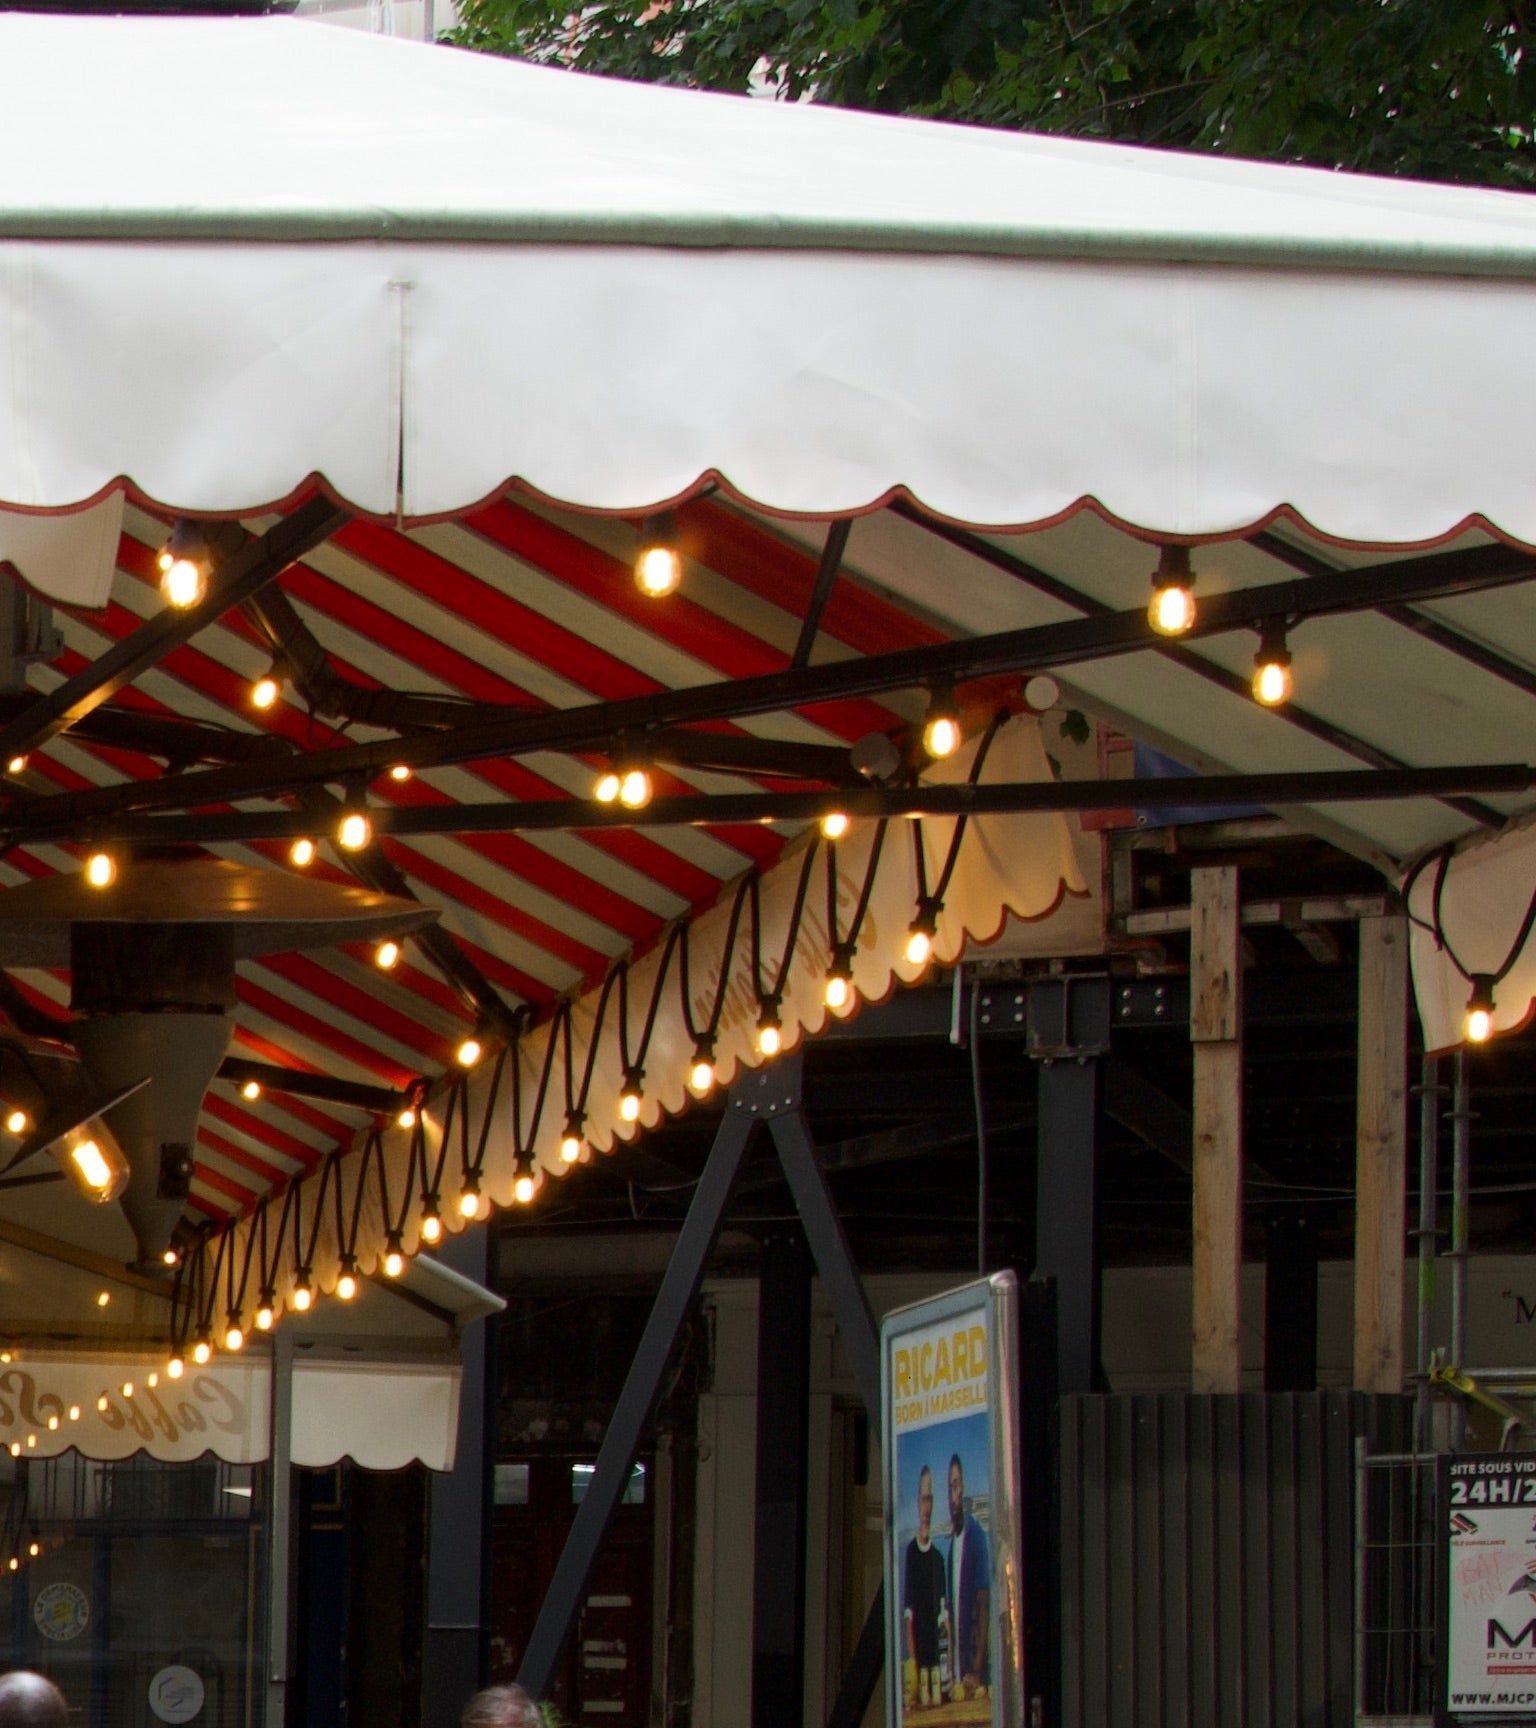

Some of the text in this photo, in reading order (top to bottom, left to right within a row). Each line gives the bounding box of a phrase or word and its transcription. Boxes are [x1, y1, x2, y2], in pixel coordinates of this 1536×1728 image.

[895, 1325, 988, 1400] RICARD
[1449, 1464, 1476, 1476] SITE
[1477, 1462, 1512, 1475] SOUS
